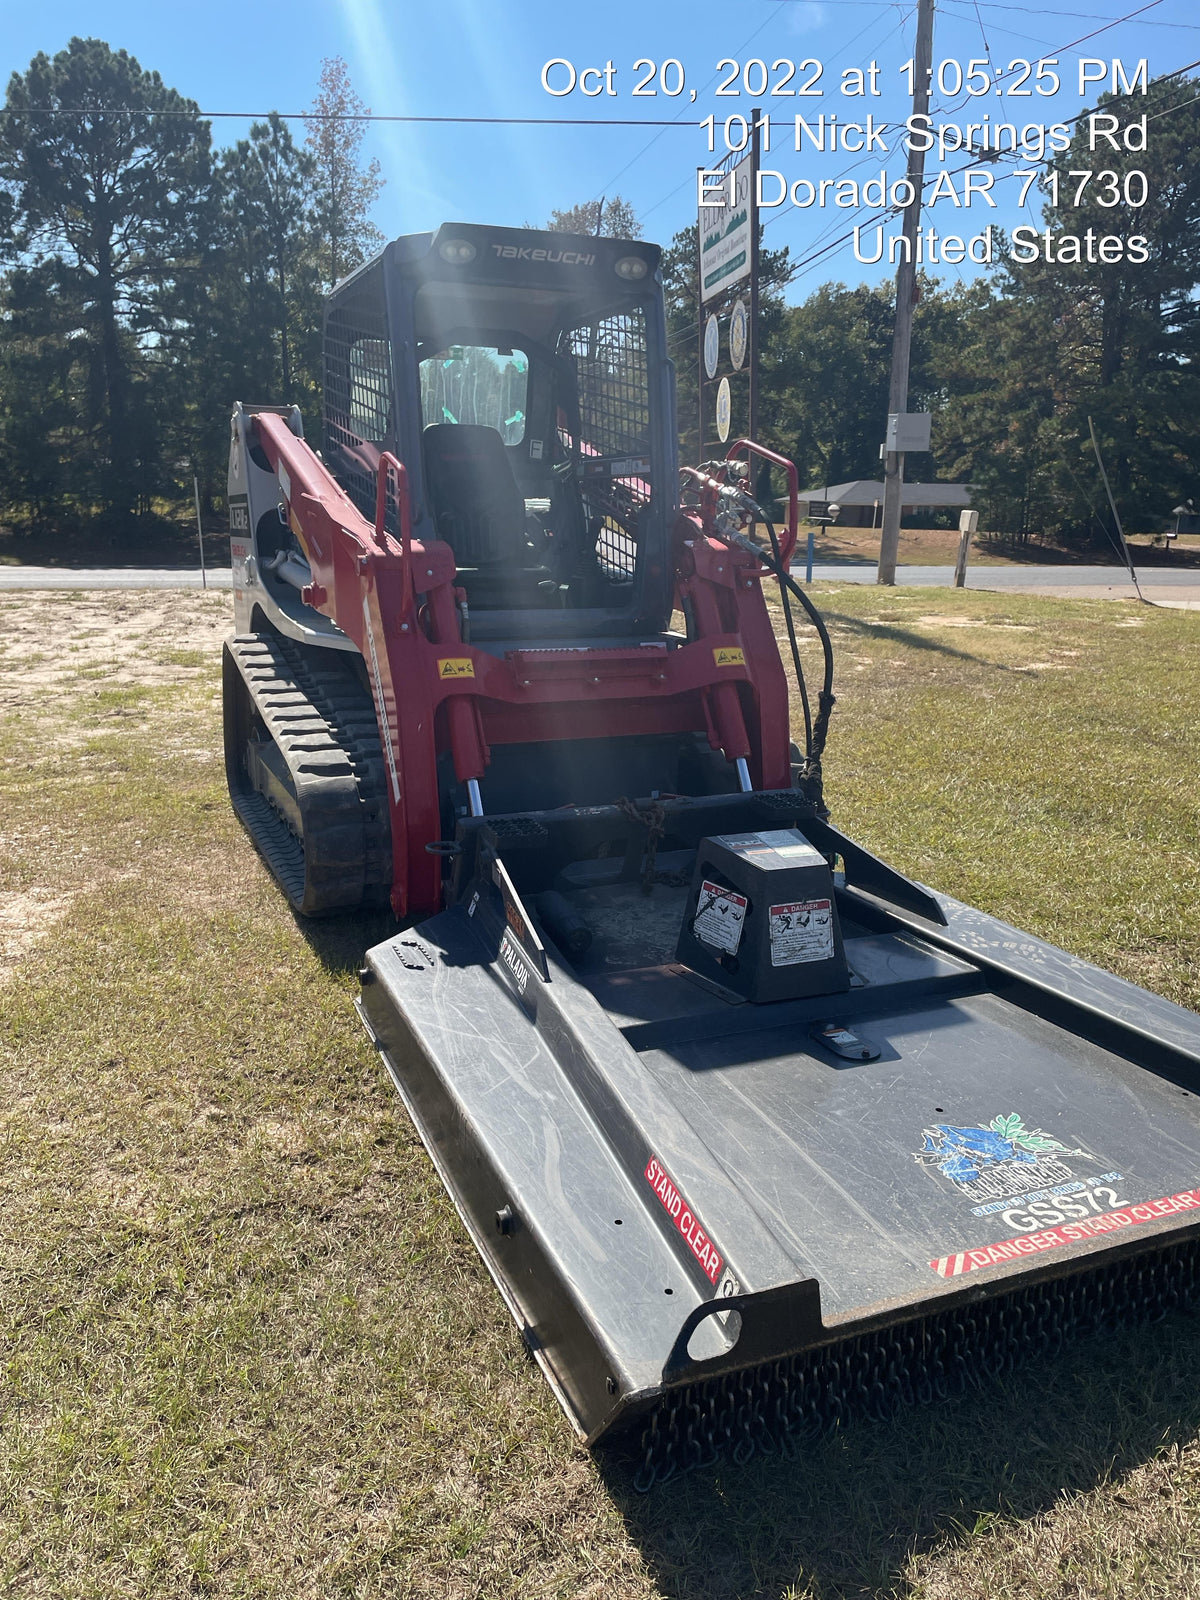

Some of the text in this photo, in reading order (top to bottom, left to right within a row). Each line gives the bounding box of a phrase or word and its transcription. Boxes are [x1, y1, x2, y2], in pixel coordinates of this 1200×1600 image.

[491, 243, 597, 266] TAKEUCHI
[790, 902, 819, 913] DANGER
[503, 943, 529, 989] PALADIN
[647, 1159, 719, 1278] STAND CLEAR
[968, 1193, 1200, 1267] DANGER STAND CLEAR
[1001, 1186, 1131, 1233] GSS72
